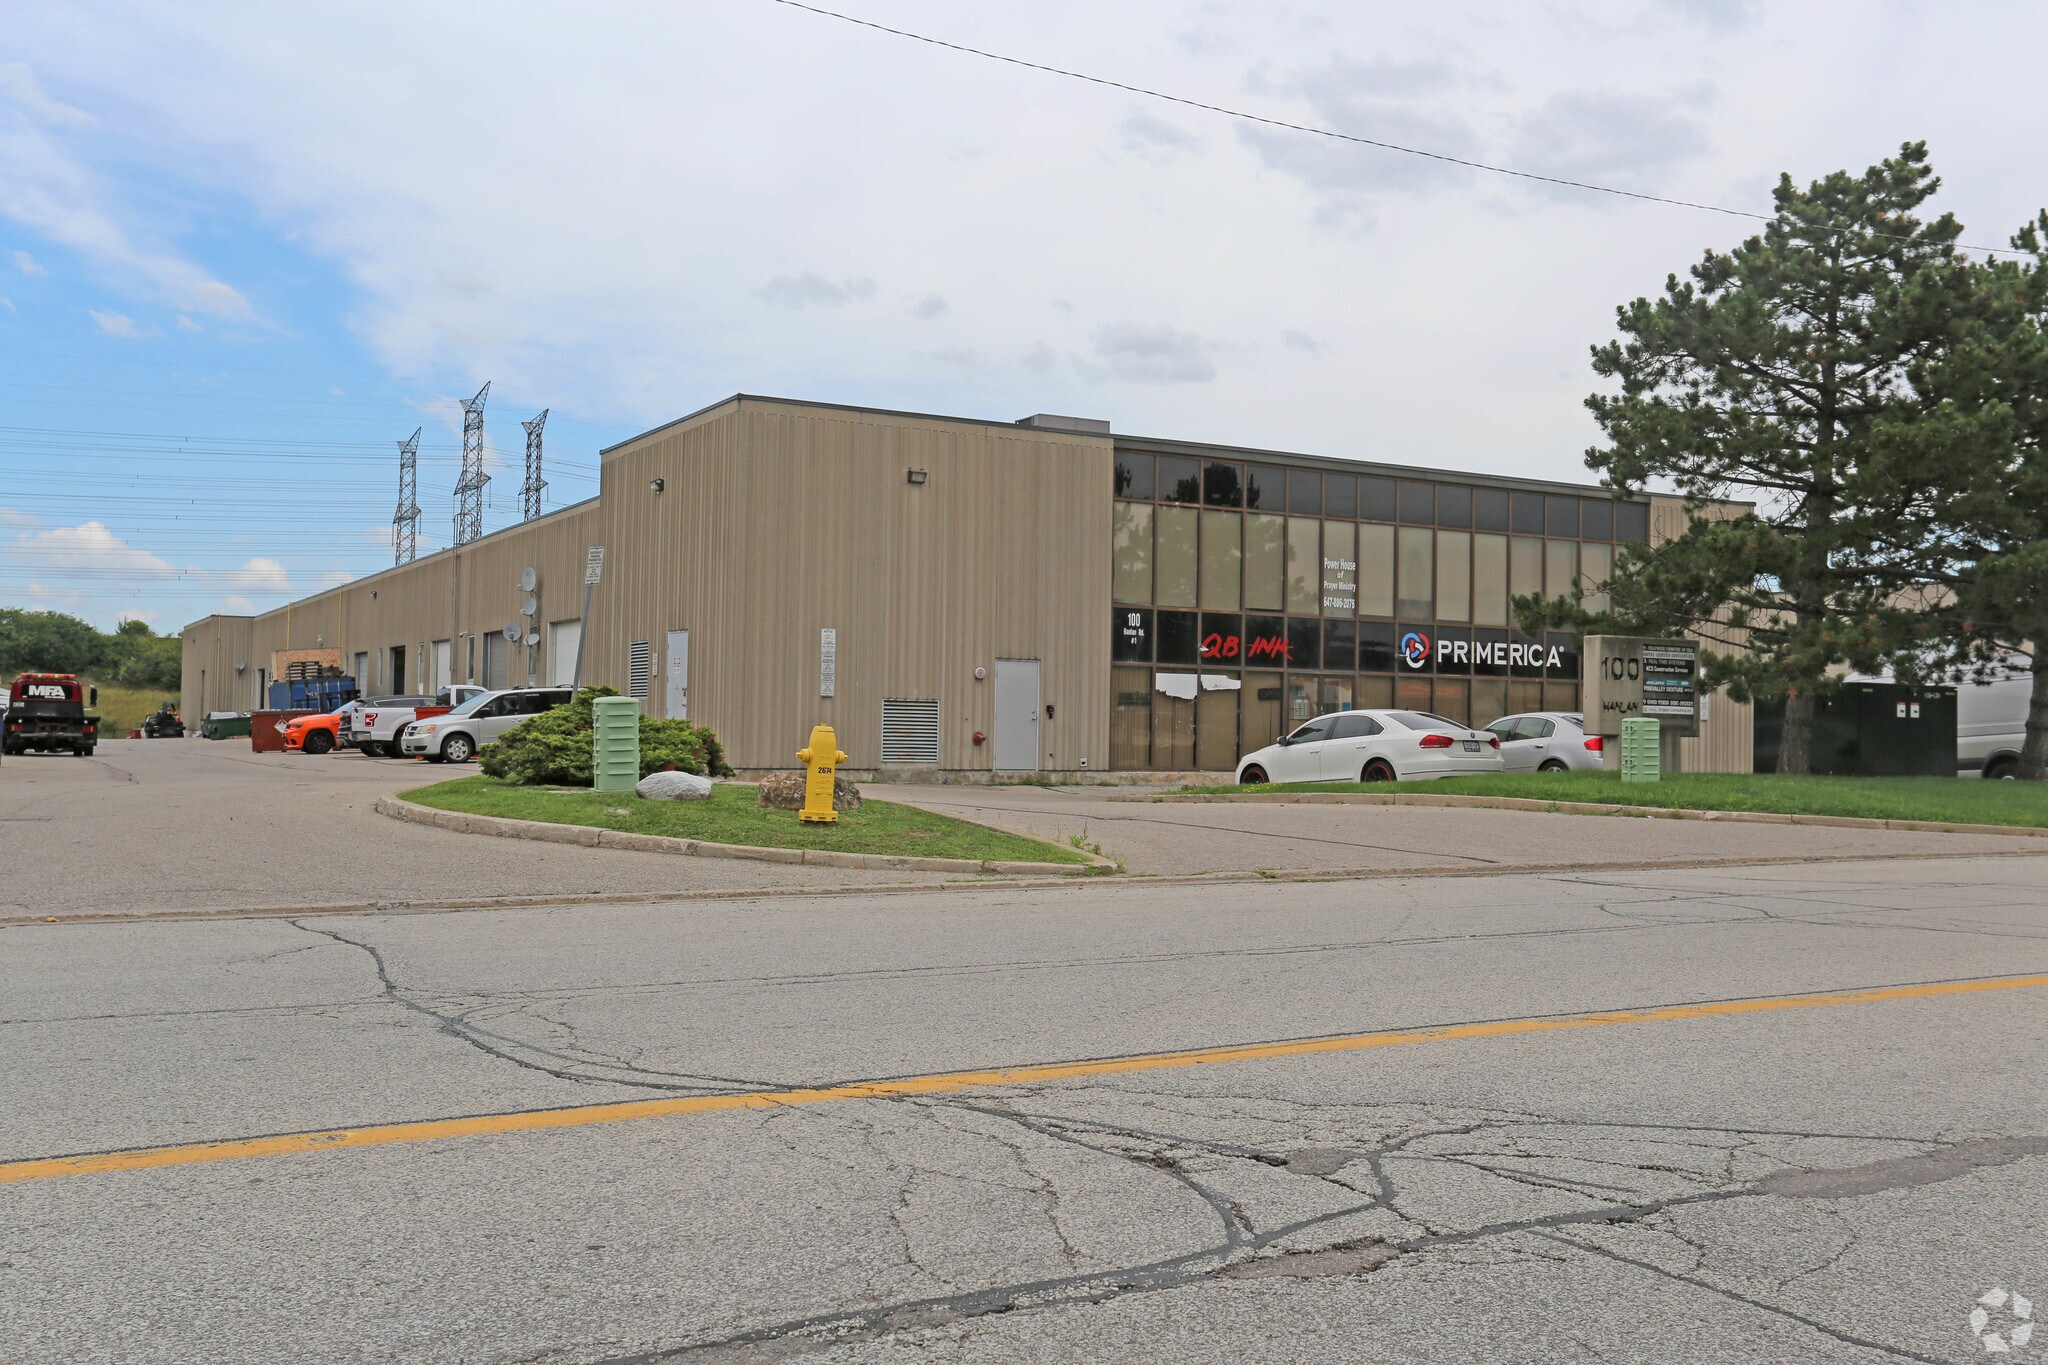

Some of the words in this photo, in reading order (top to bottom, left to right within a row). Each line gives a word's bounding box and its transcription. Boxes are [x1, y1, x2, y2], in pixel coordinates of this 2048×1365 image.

[1325, 558, 1339, 569] Power
[1340, 559, 1356, 570] House
[1324, 581, 1338, 591] Prayer
[1339, 582, 1356, 592] Ministry
[1128, 613, 1141, 626] 100
[1201, 633, 1241, 658] QB
[1246, 635, 1294, 660] INK
[1602, 657, 1639, 680] 100
[29, 685, 65, 696] MFA
